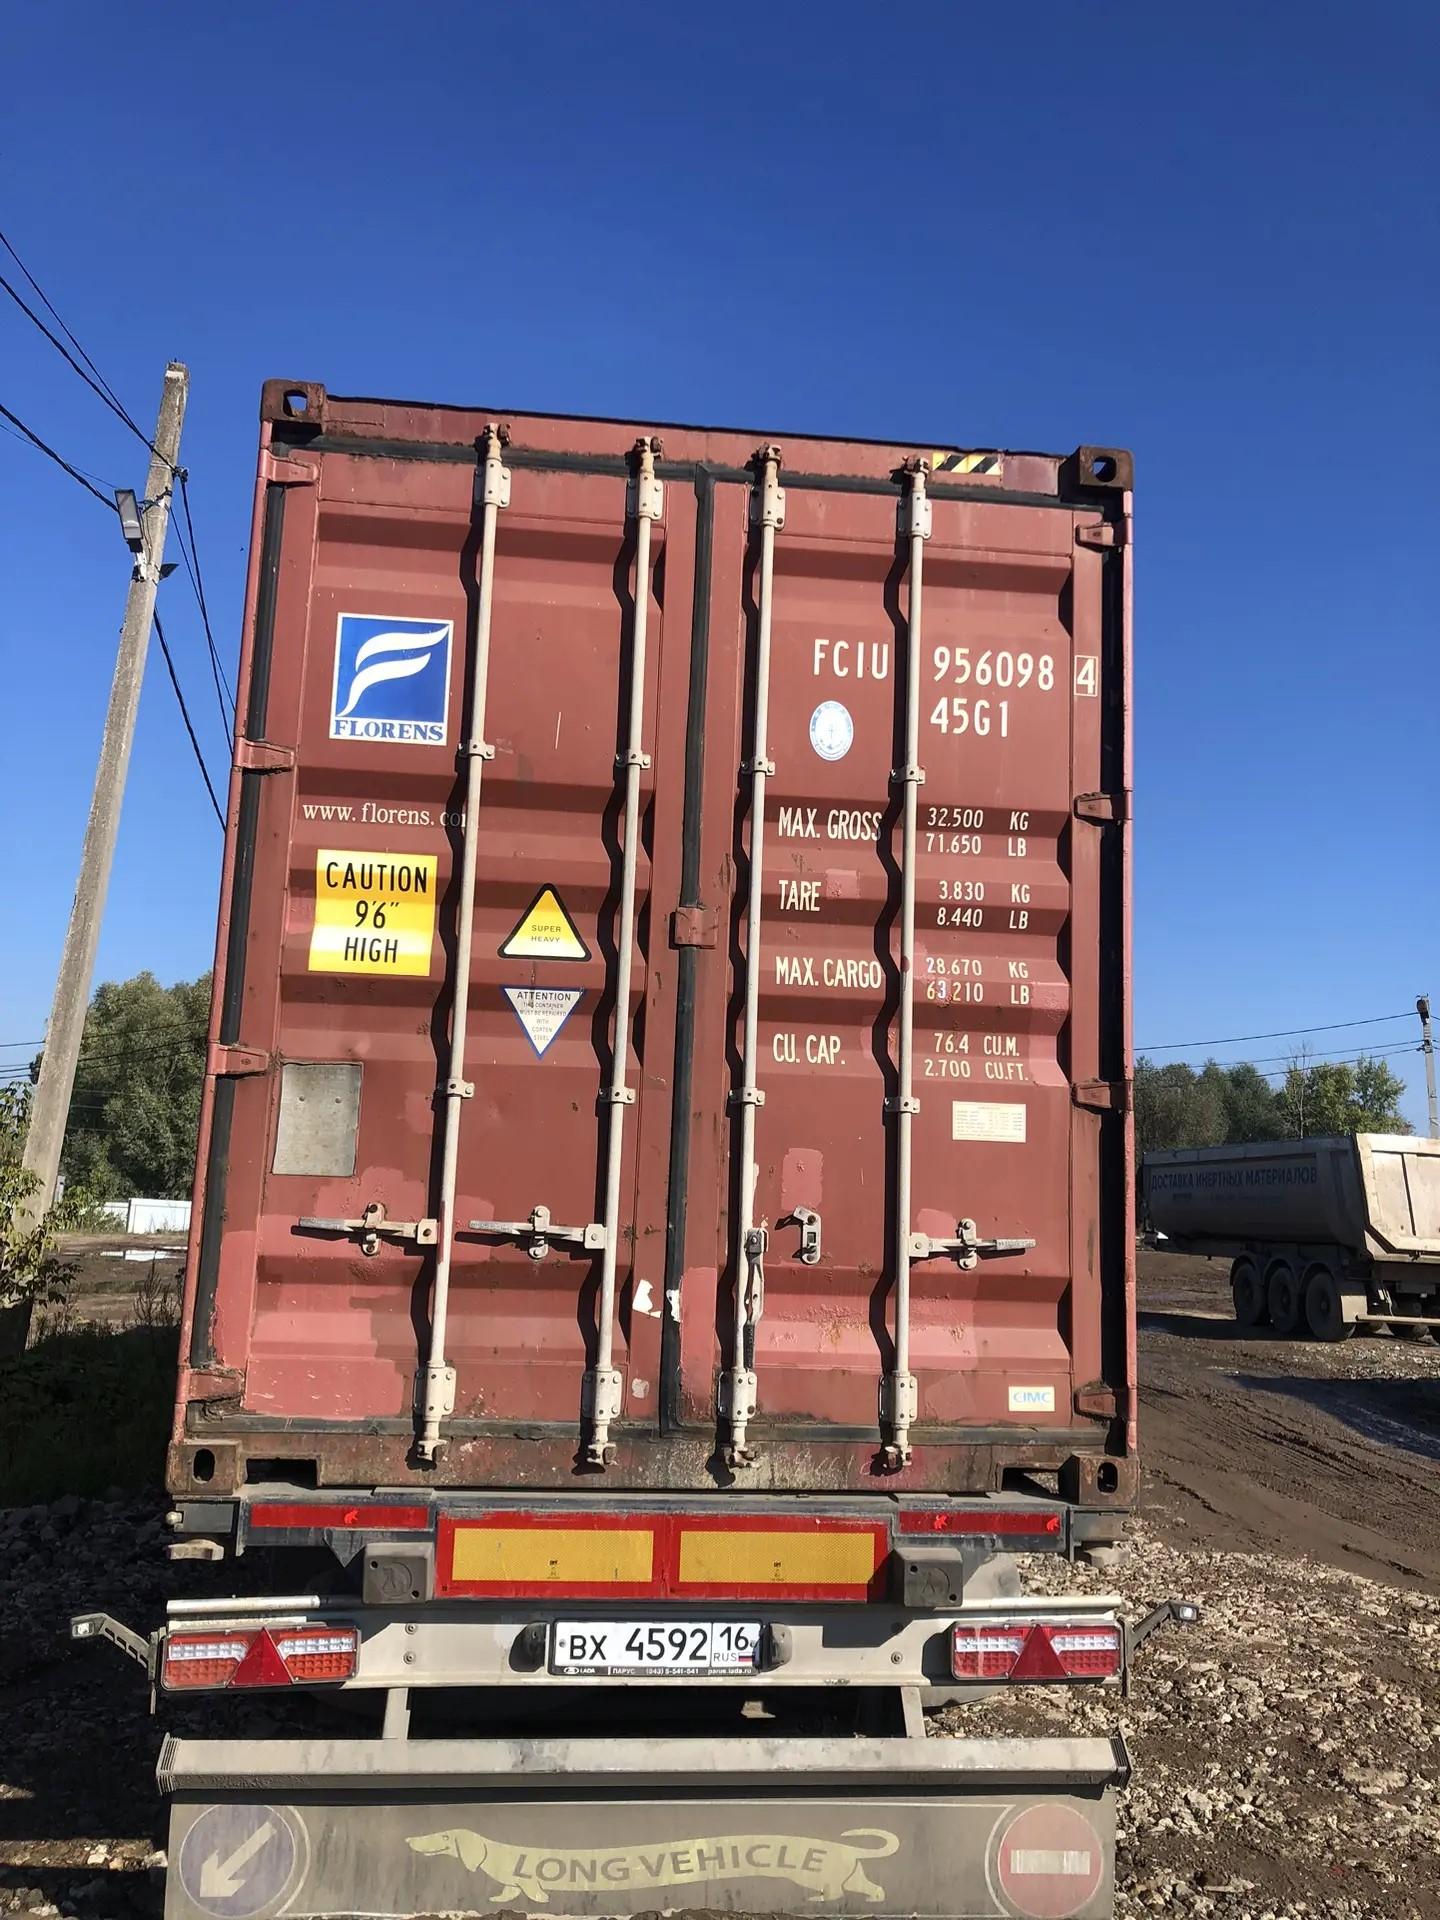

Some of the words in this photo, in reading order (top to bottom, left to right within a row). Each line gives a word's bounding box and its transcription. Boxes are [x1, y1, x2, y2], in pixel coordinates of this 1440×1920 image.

[813, 639, 889, 679] FCIU
[933, 646, 1054, 691] 956098
[1075, 658, 1096, 694] 4
[930, 697, 1009, 738] 45G1
[334, 719, 444, 742] FLORENS
[778, 806, 821, 838] MAX.
[827, 809, 882, 841] GROSS
[1009, 811, 1029, 830] KG
[1008, 837, 1027, 857] LB
[325, 861, 428, 893] CAUTION
[778, 880, 822, 912] TARE
[1011, 883, 1031, 904] KG
[1009, 910, 1029, 929] LB
[344, 936, 398, 964] HIGH
[775, 956, 819, 987] MAX.
[823, 959, 882, 989] CARGO
[1008, 961, 1029, 979] KG
[517, 991, 571, 1001] ATTENTION
[1010, 984, 1030, 1005] LB
[772, 1033, 801, 1063] CU.
[806, 1035, 846, 1065] CAP.
[934, 1032, 969, 1054] 76.4
[983, 1035, 1020, 1057] CU.M.
[985, 1061, 1029, 1081] CU.FT.
[1151, 1172, 1194, 1191] ДОСТАВКА
[1196, 1170, 1243, 1188] ИНЕРТНЫХ
[1245, 1166, 1318, 1185] МАТЕРИАЛОВ
[1013, 1391, 1051, 1403] CIMC
[625, 1628, 708, 1661] 4592
[719, 1626, 749, 1651] 16
[713, 1653, 737, 1662] RUS
[512, 1853, 631, 1883] LONG
[637, 1844, 828, 1879] VEHICLE
